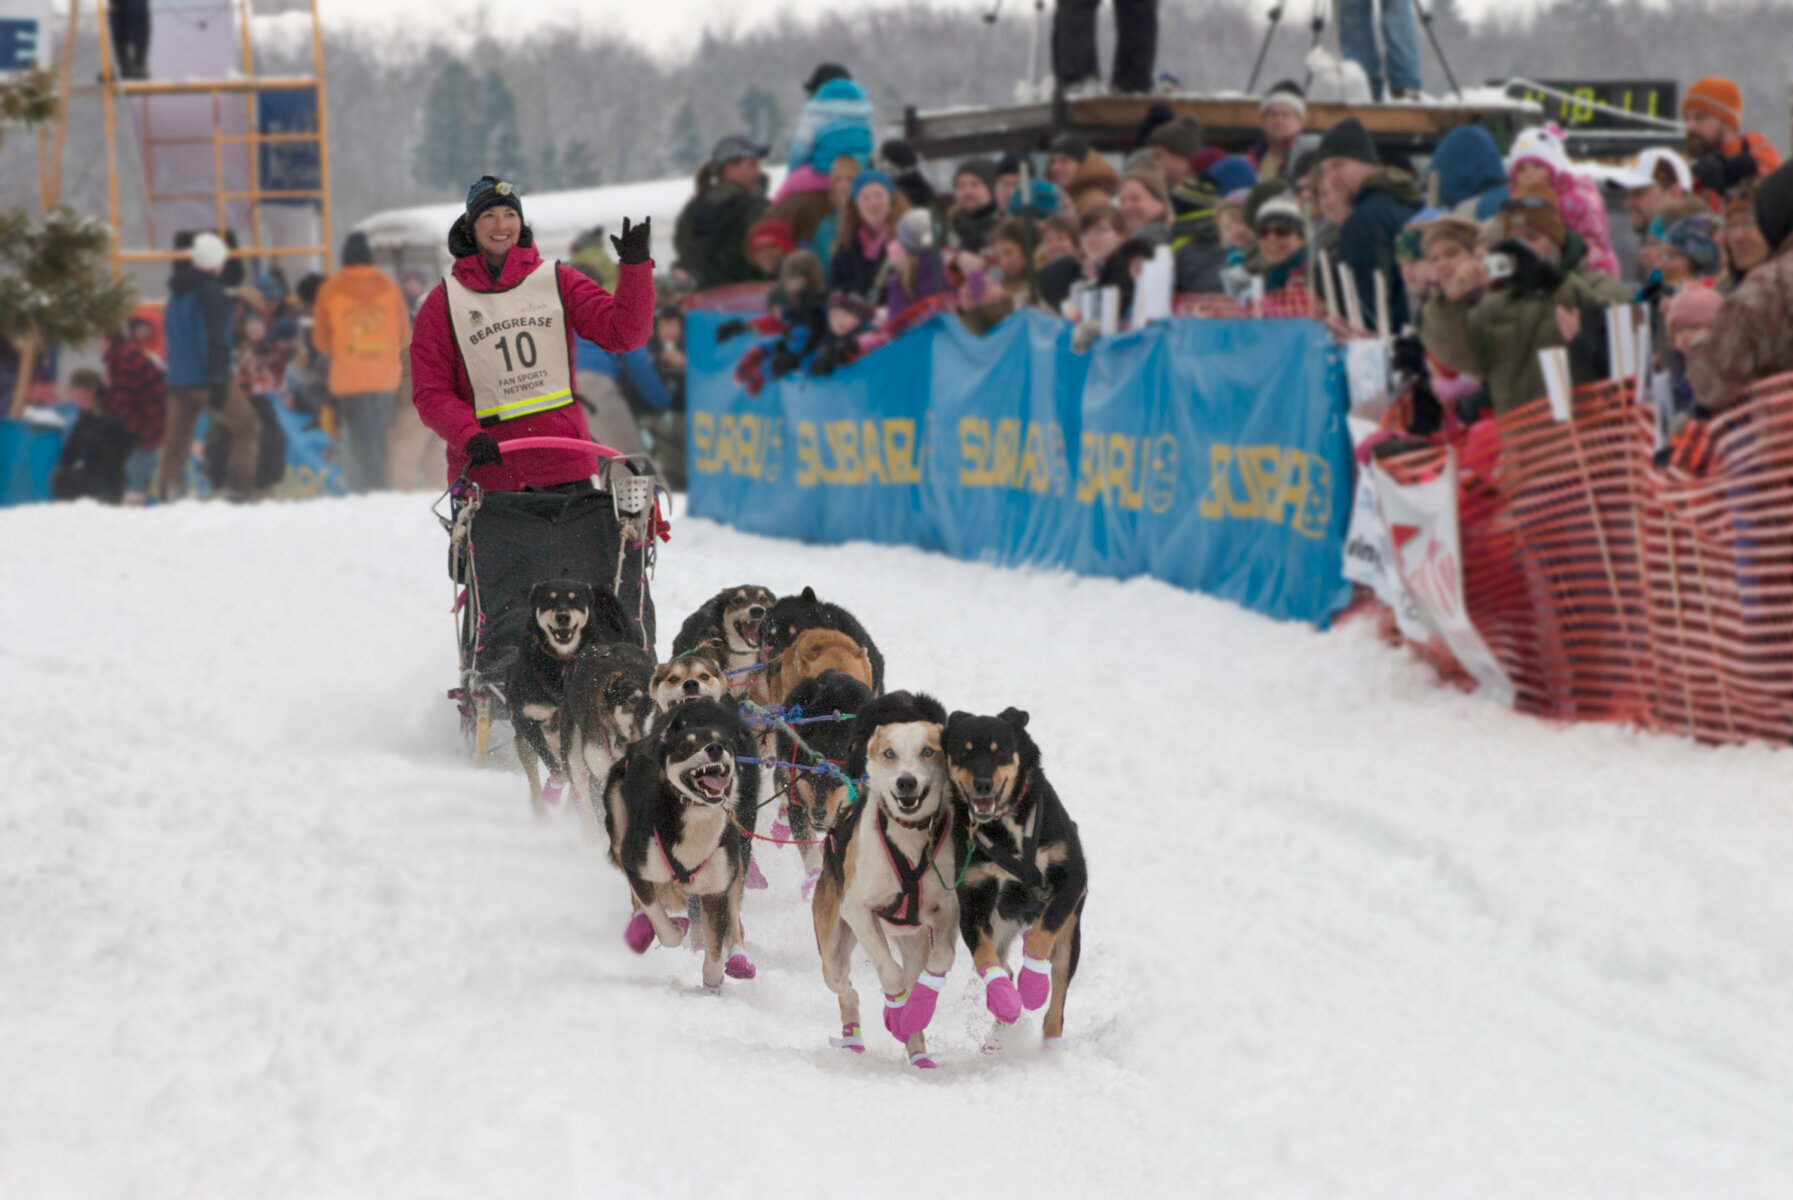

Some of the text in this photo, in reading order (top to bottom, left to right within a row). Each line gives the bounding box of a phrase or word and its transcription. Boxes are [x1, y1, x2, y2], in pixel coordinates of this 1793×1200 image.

[469, 316, 553, 345] BEARGREASE
[495, 331, 537, 372] 10
[498, 369, 548, 387] FAN SPORTS
[503, 380, 544, 394] NETWORK
